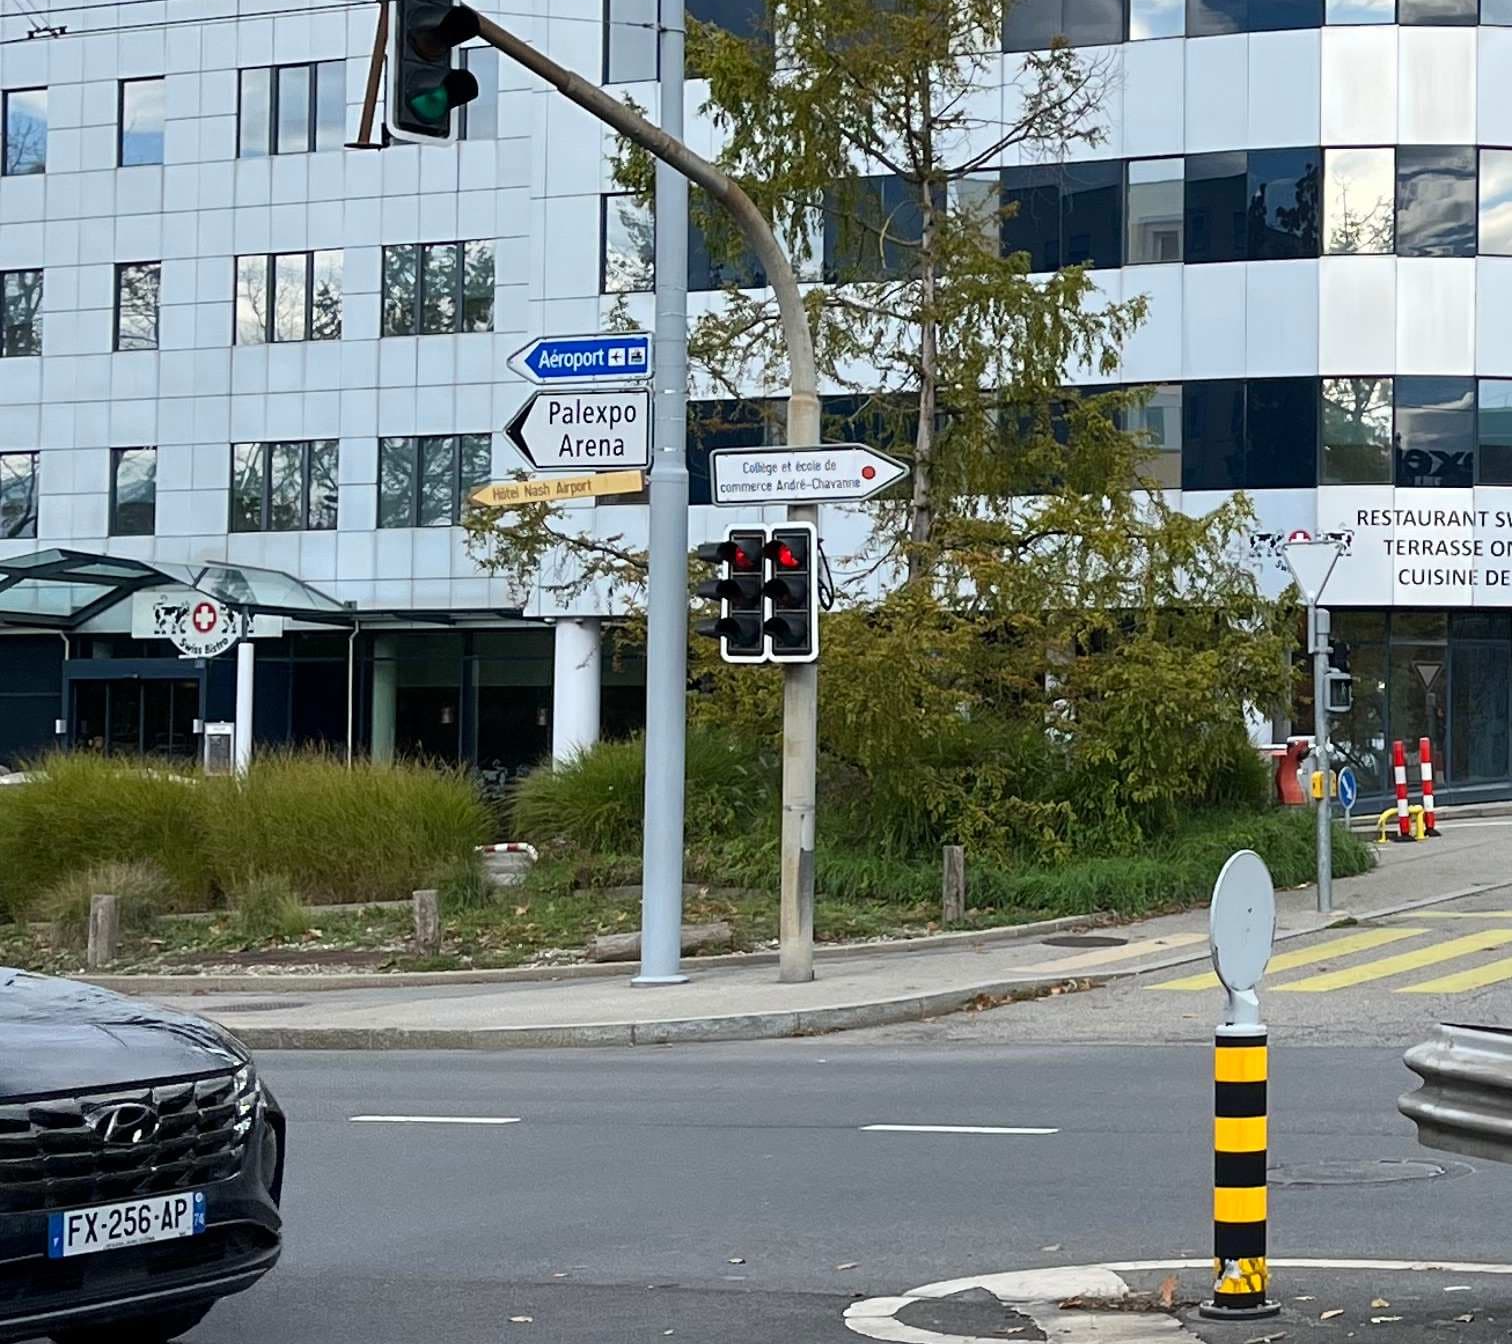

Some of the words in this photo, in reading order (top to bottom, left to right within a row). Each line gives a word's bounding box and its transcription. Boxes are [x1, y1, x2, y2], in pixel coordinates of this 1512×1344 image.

[538, 348, 604, 372] Aéroport
[549, 398, 636, 430] Palexpo
[558, 433, 625, 457] Arena
[742, 461, 778, 476] Collège
[781, 463, 792, 472] et
[795, 460, 822, 472] école
[824, 459, 837, 470] de
[492, 487, 519, 501] Hôtel
[524, 483, 551, 497] Nash
[556, 480, 592, 496] Airport
[720, 482, 773, 493] commerce
[1356, 509, 1489, 528] RESTAURANT
[1383, 539, 1484, 557] TERRASSE
[1398, 568, 1478, 587] CUISINE
[1485, 569, 1512, 587] DE
[179, 637, 202, 654] Swiss
[204, 637, 229, 654] Bistro
[67, 1199, 188, 1247] FX-256-AP
